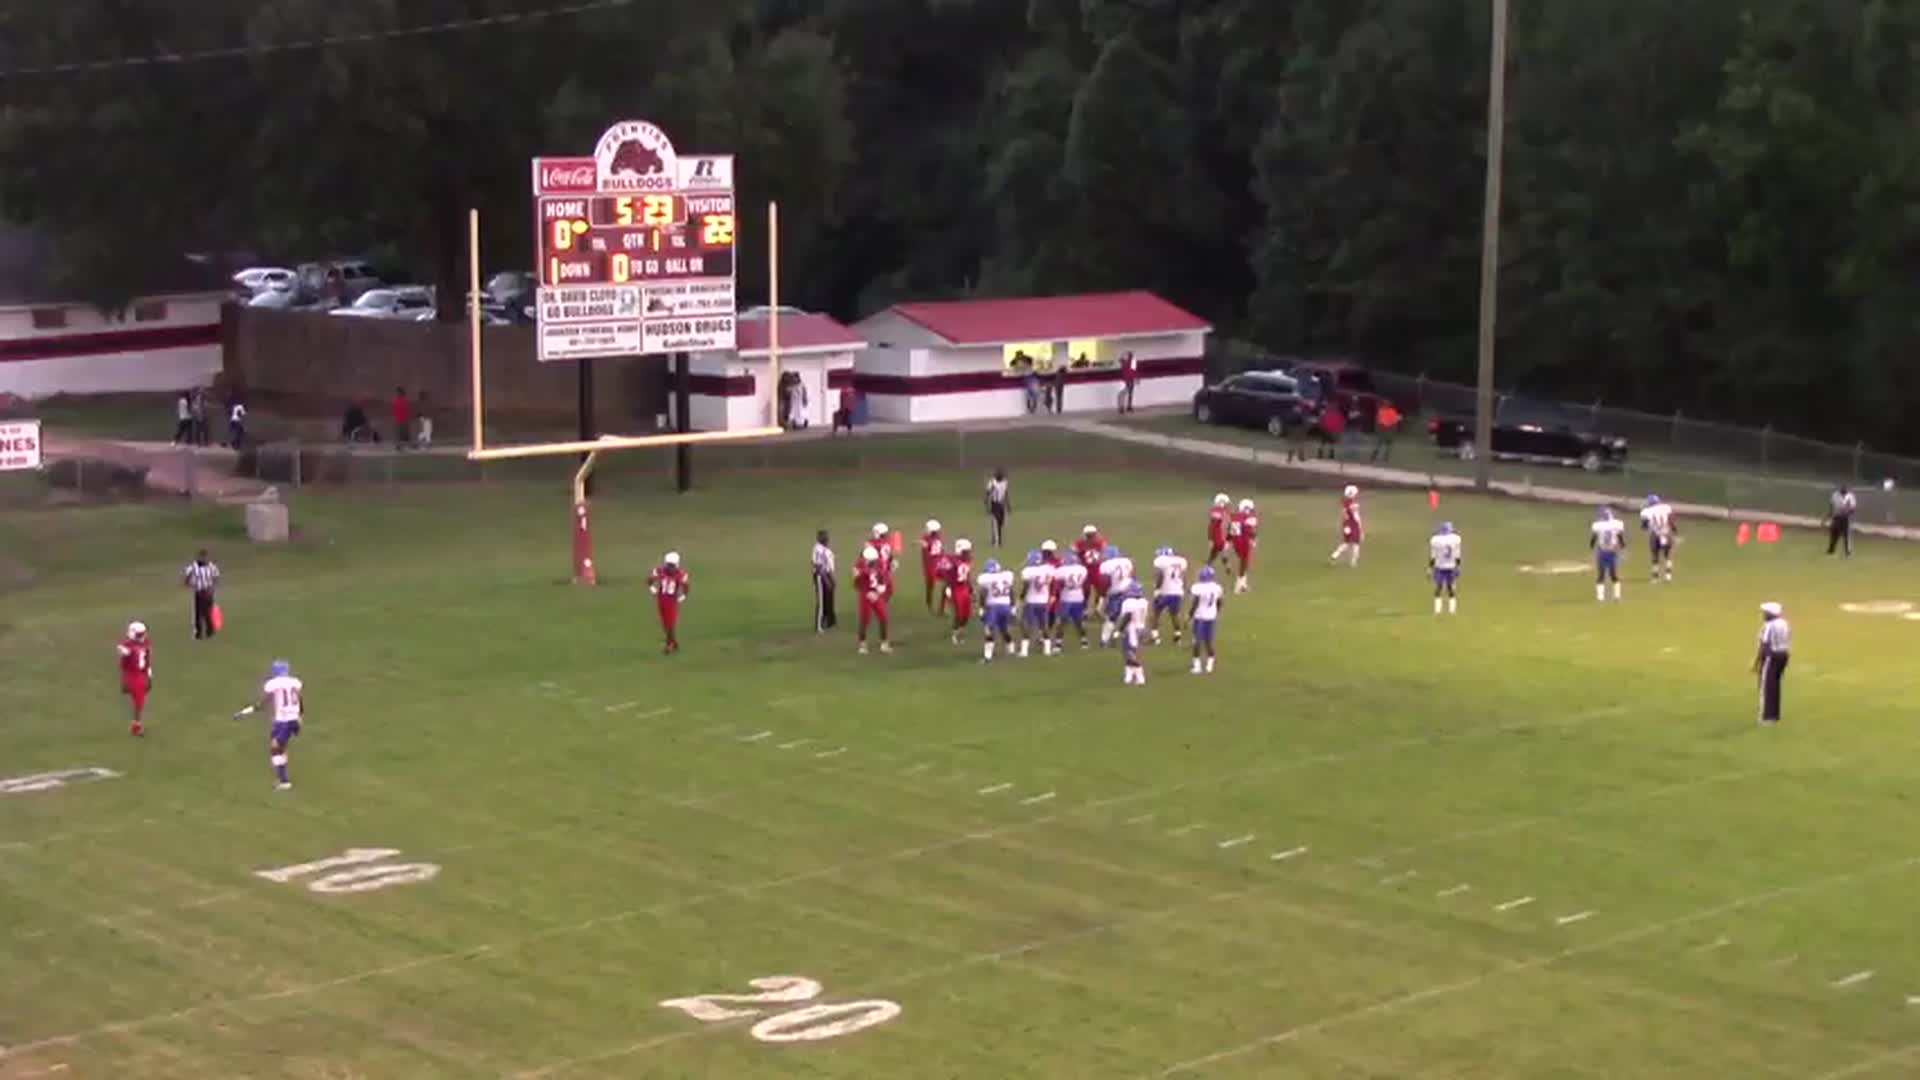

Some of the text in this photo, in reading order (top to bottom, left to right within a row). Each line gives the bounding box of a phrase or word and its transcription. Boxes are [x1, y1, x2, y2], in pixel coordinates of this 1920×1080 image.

[602, 178, 673, 189] BULLDOGS
[546, 202, 585, 217] HOME
[688, 198, 731, 213] VISITOR
[555, 220, 571, 249] 0
[560, 262, 591, 278] DOWN
[612, 254, 628, 283] 0
[665, 258, 688, 274] BALL
[645, 319, 732, 336] HUDSON DRUGS
[253, 848, 441, 892] 10
[658, 976, 902, 1041] 20
